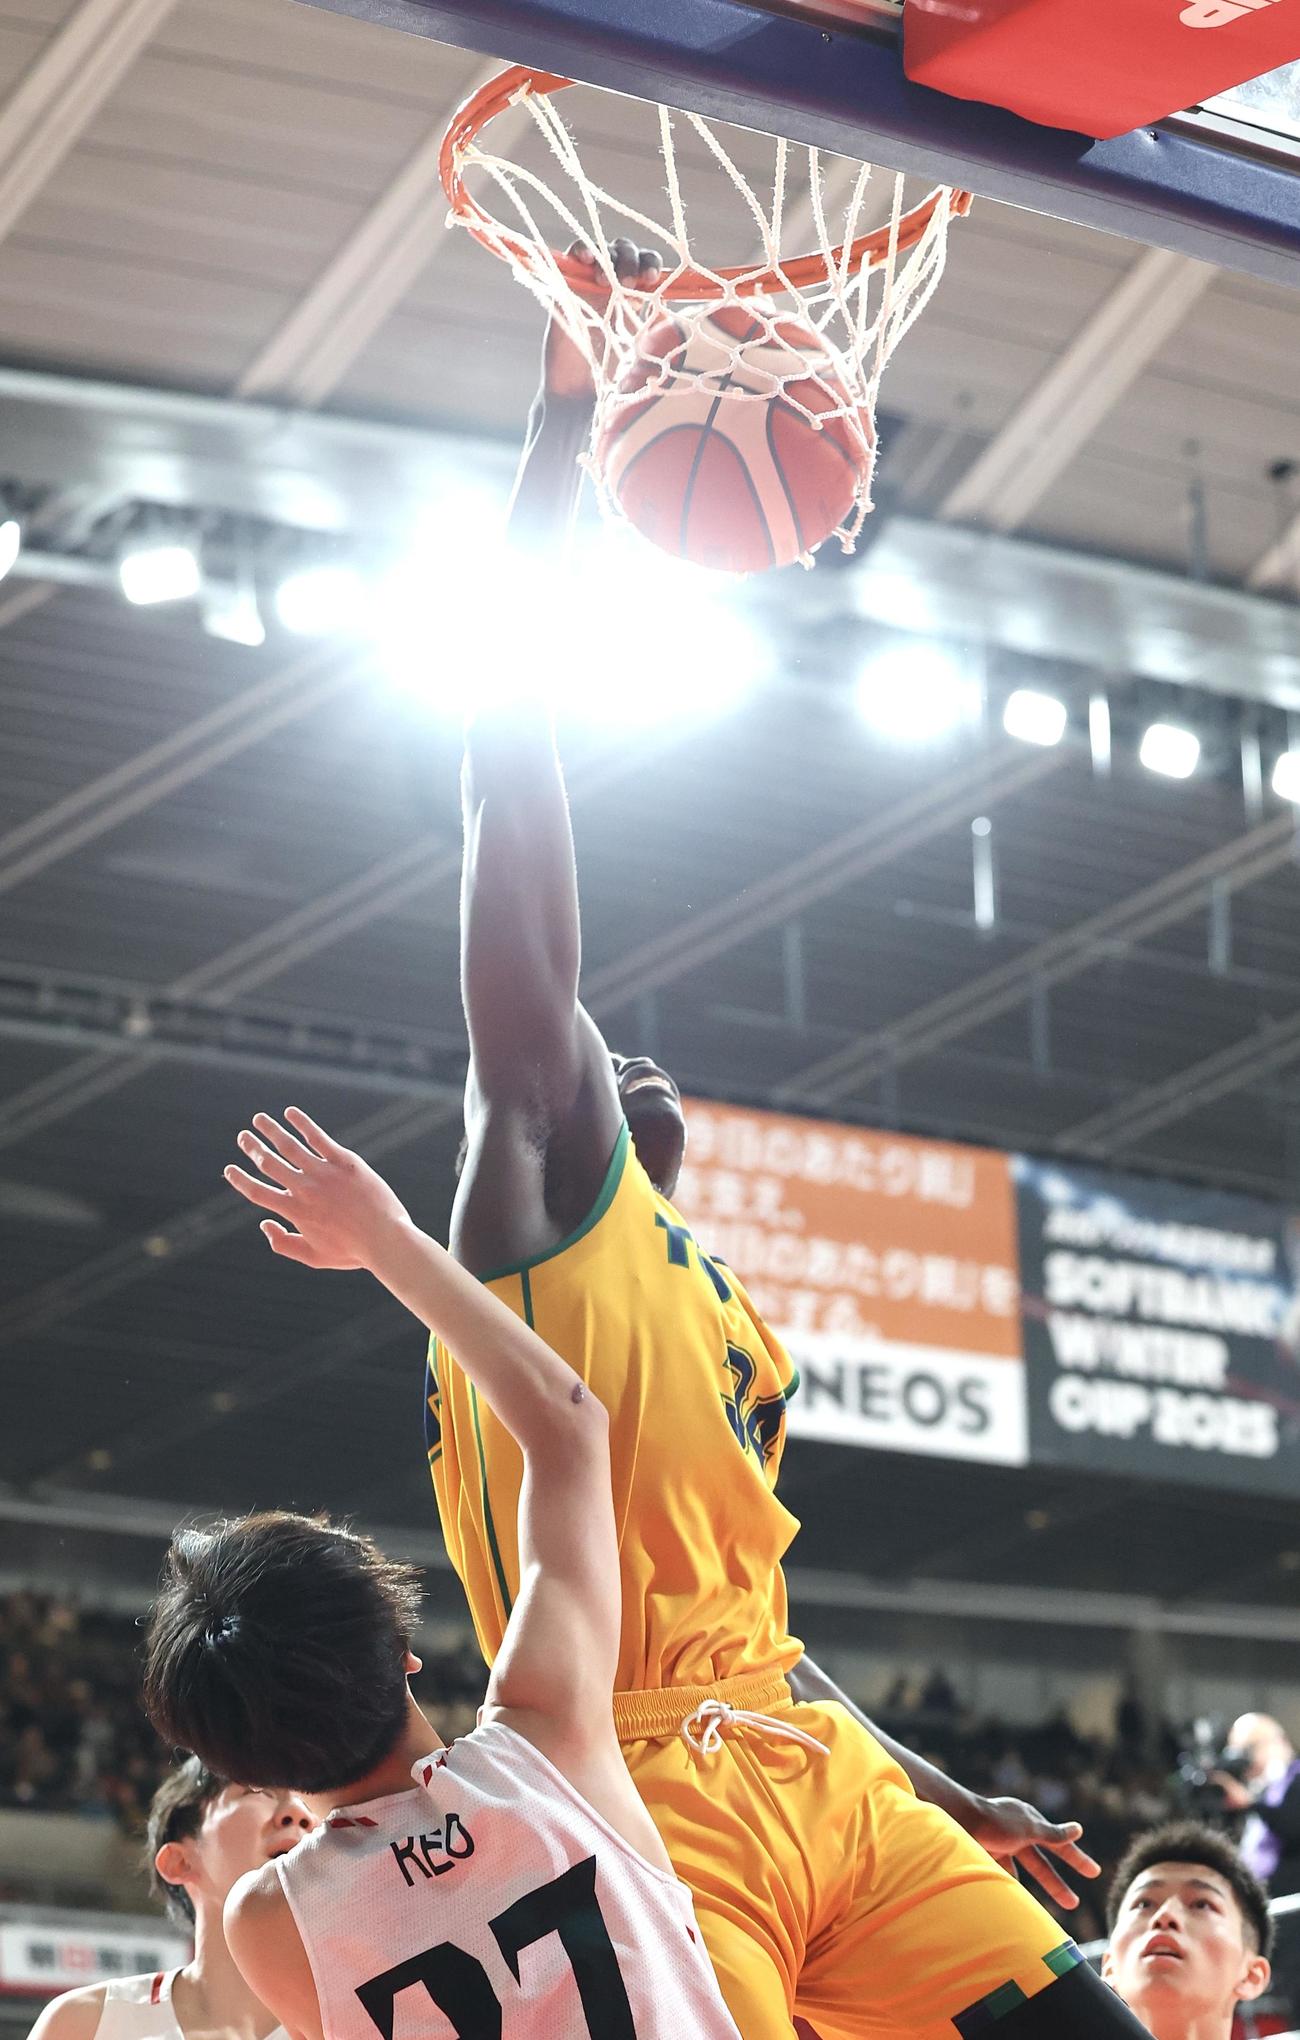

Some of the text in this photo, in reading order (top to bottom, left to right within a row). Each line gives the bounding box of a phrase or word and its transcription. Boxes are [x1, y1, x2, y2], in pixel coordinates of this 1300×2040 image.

[1047, 1308, 1230, 1390] WINTER
[800, 1352, 995, 1437] NEOS
[1050, 1371, 1150, 1440] CUP
